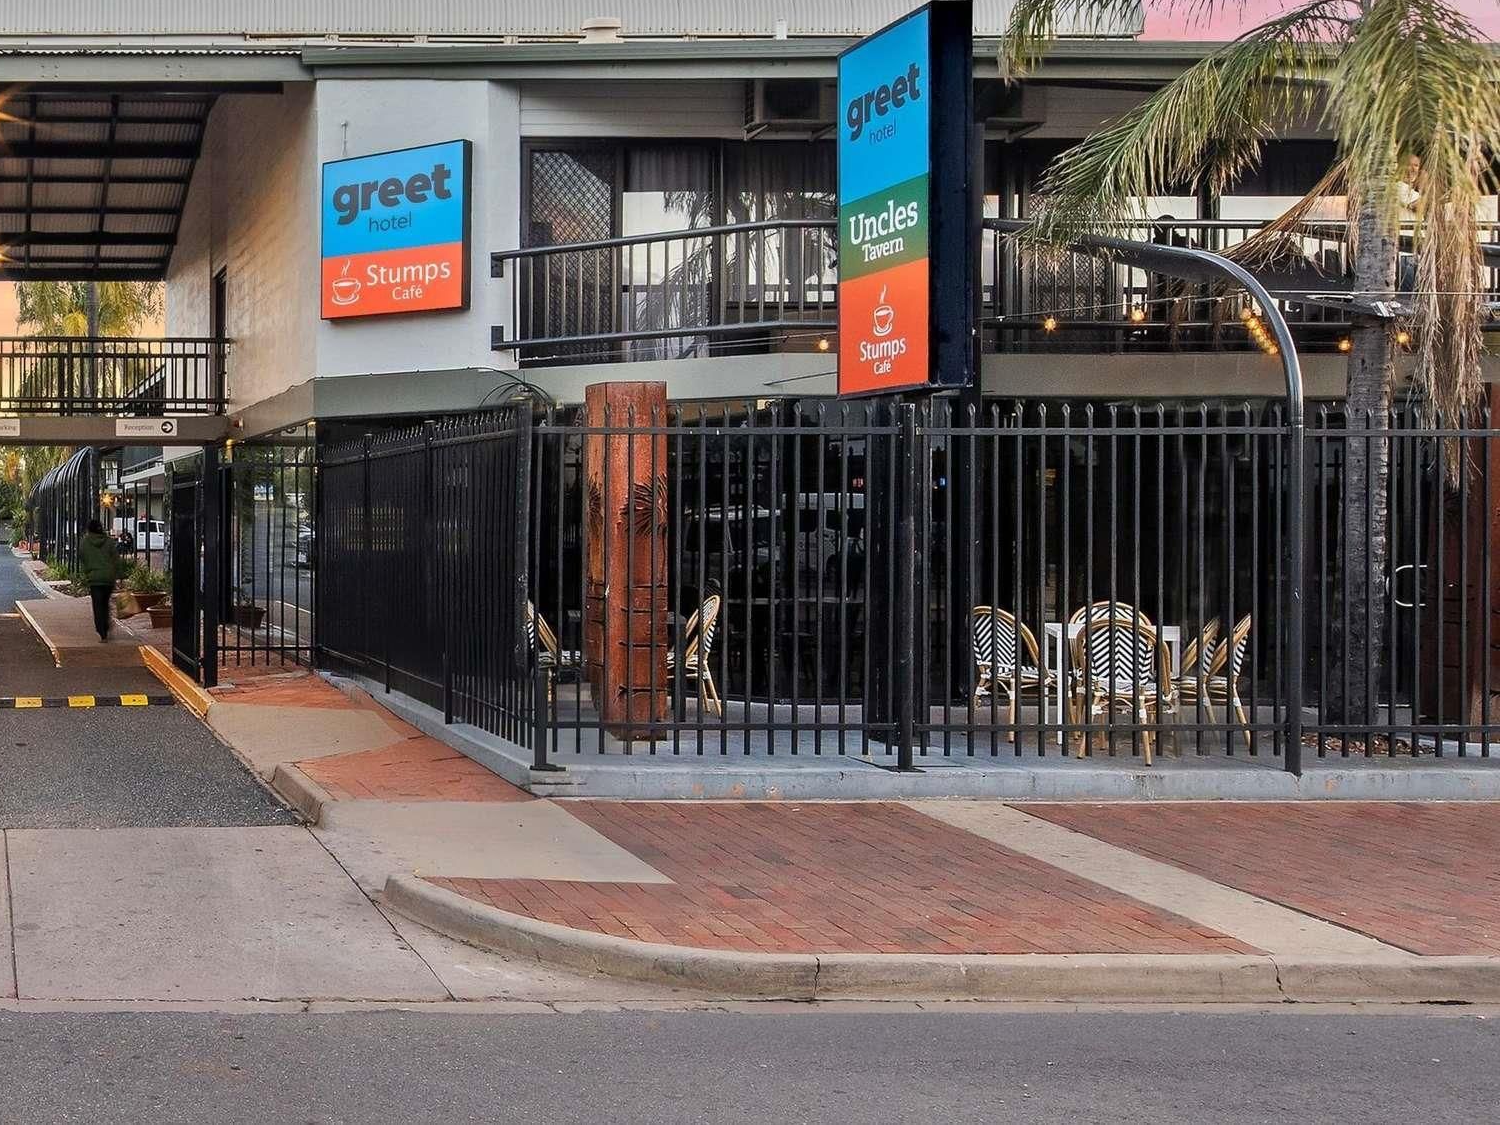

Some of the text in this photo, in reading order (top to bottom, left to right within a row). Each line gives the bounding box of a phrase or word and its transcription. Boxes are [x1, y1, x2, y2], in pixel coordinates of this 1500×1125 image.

[847, 62, 920, 141] greet
[869, 116, 897, 146] hotel
[333, 164, 452, 225] greet
[369, 211, 412, 232] hotel
[849, 200, 919, 245] Uncles
[862, 234, 904, 262] Tavern
[367, 262, 450, 286] Stumps
[392, 285, 423, 300] Café
[860, 335, 906, 363] Stumps
[873, 359, 892, 375] Café
